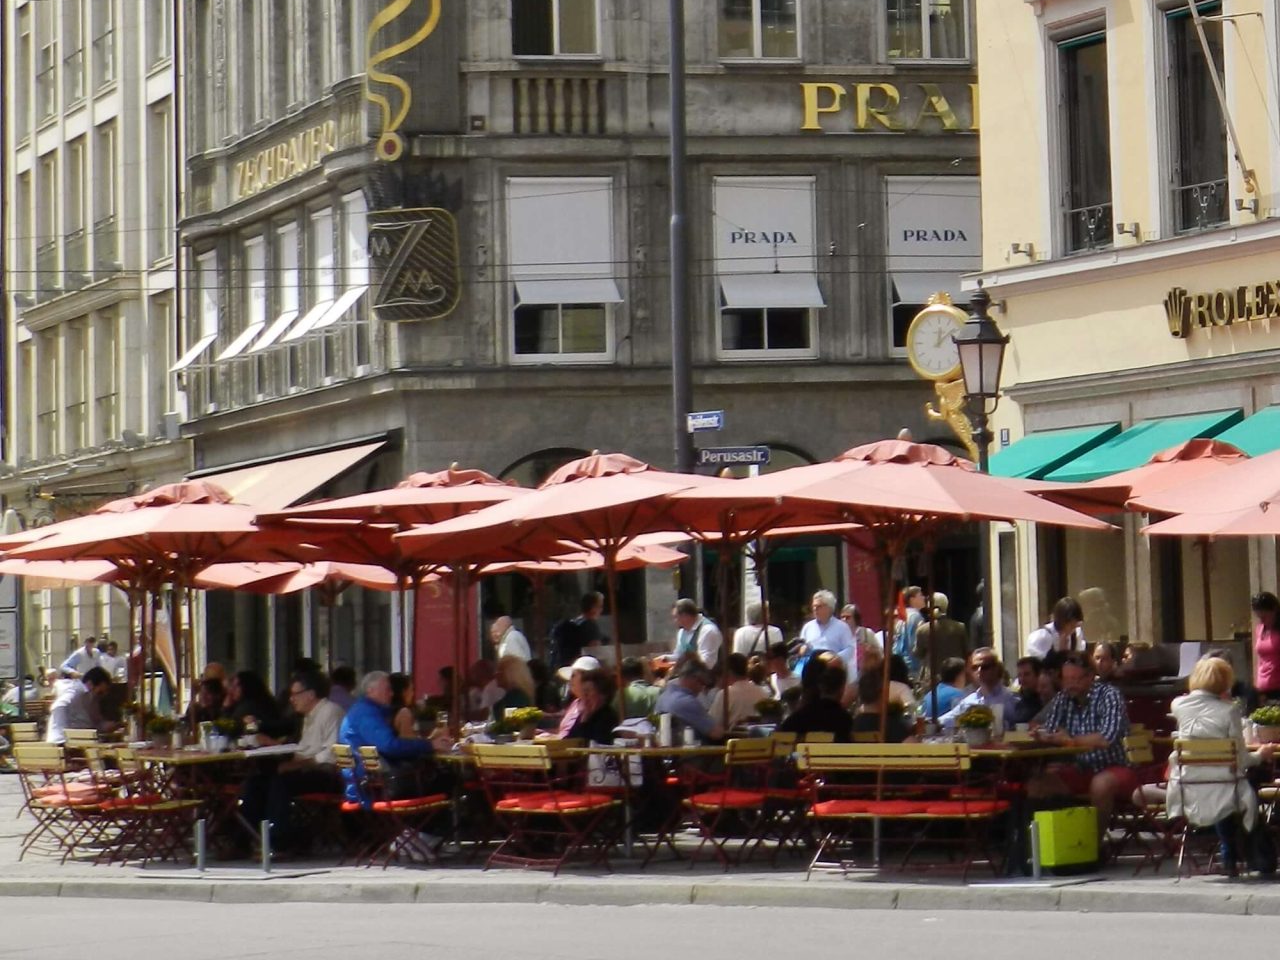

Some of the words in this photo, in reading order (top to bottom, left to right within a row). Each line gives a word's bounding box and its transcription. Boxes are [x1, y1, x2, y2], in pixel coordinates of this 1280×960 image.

[800, 82, 979, 130] PRA
[236, 119, 336, 199] ZECHBAUER
[730, 231, 798, 244] PRADA
[903, 228, 968, 242] PRADA
[701, 449, 766, 463] Perusastr.
